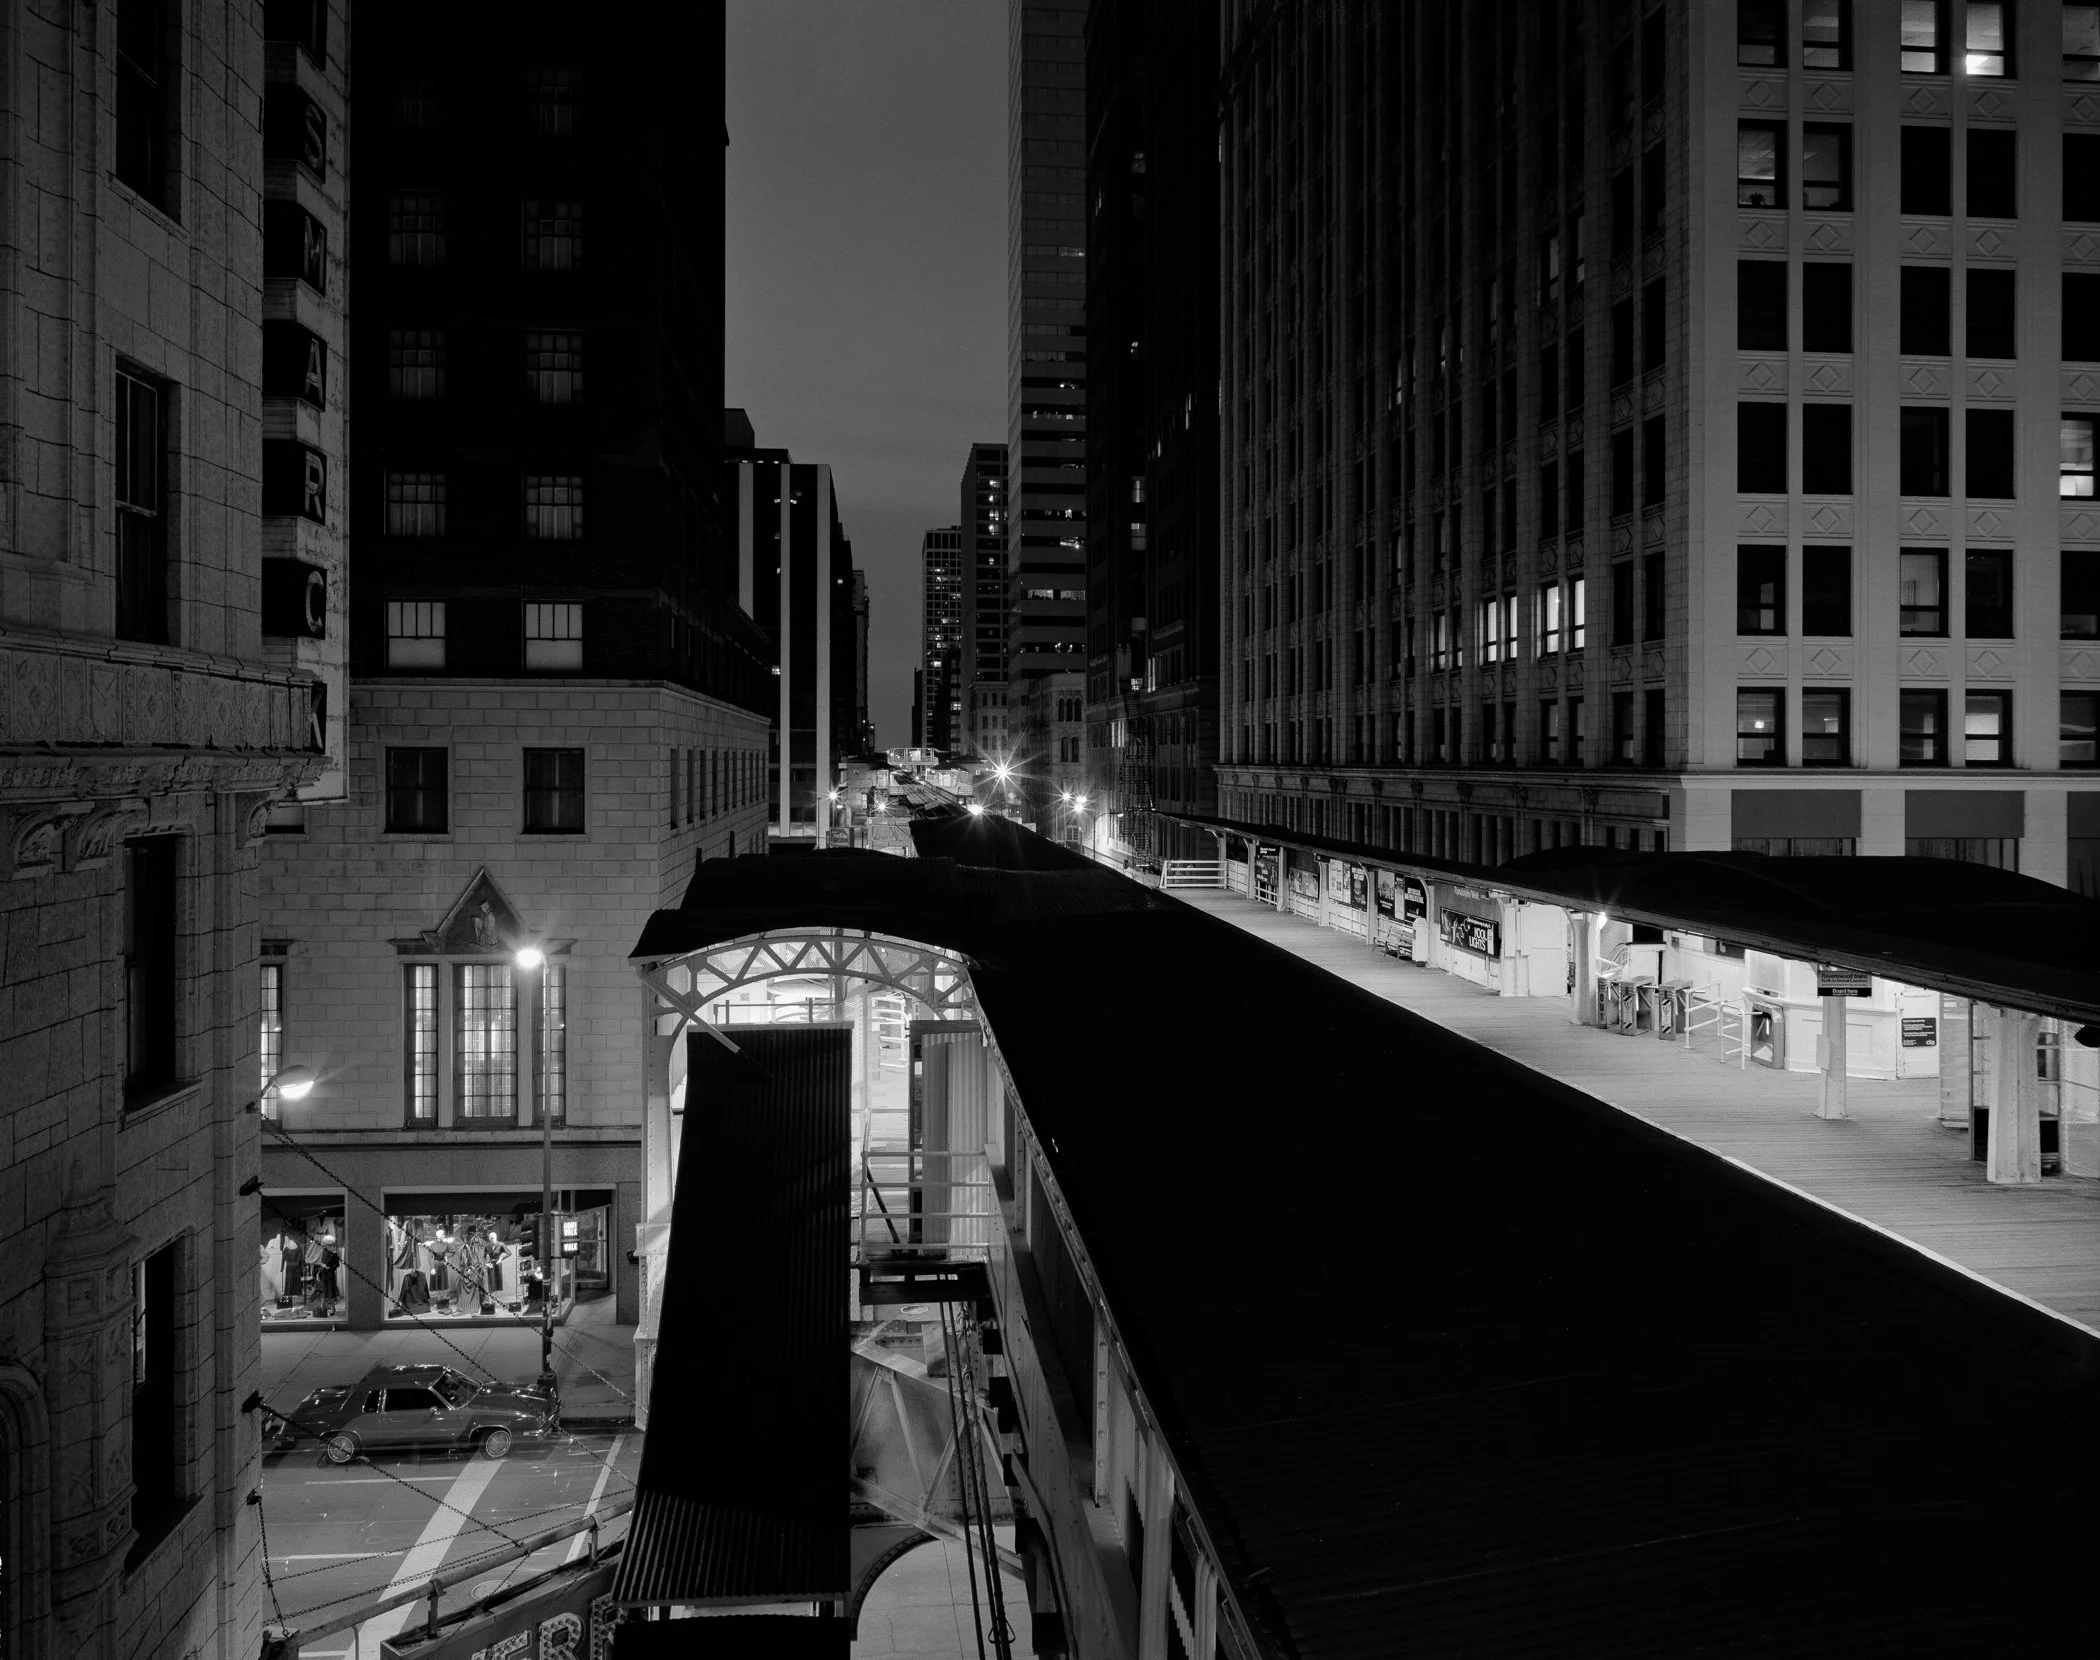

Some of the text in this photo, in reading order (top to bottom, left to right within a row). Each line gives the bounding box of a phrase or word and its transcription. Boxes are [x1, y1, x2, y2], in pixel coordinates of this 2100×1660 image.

[1474, 927, 1487, 941] KOOL
[1469, 935, 1486, 951] LIGHTS
[564, 1228, 577, 1236] WALK
[564, 1242, 577, 1251] WALK
